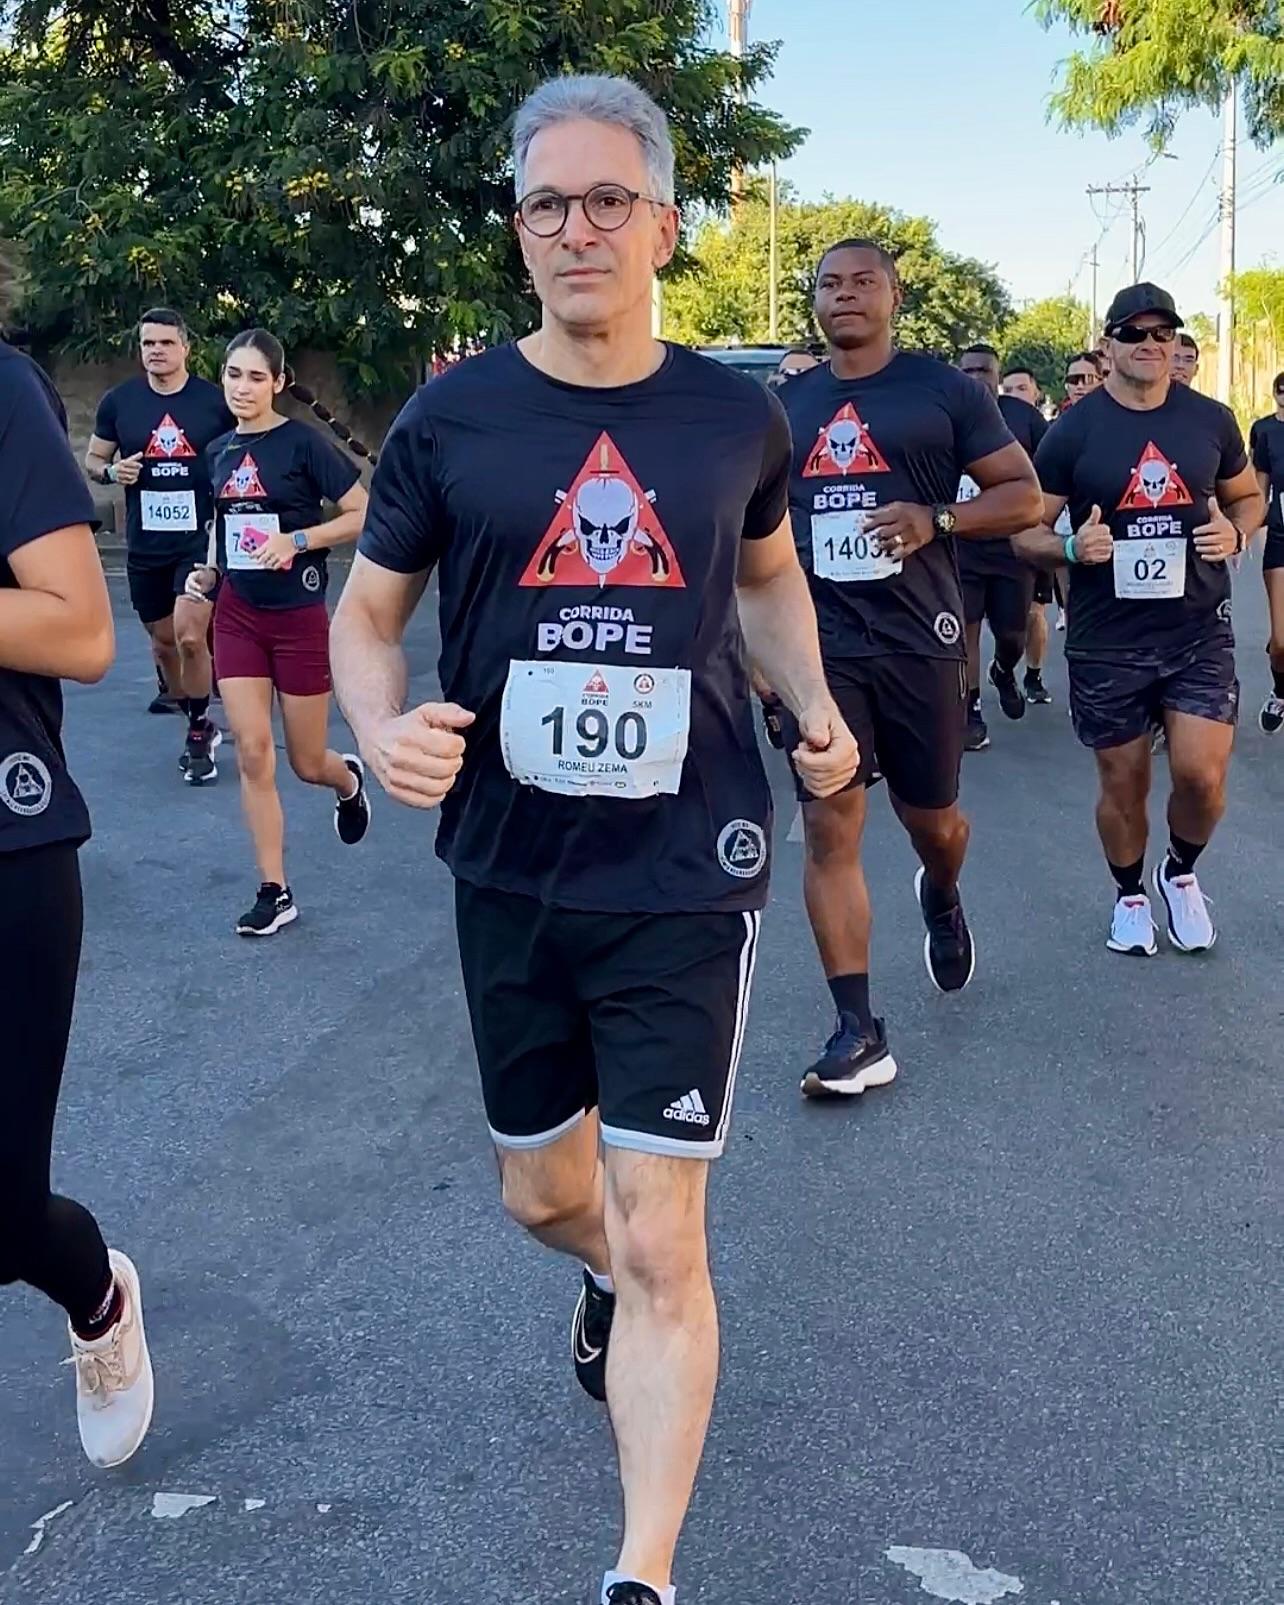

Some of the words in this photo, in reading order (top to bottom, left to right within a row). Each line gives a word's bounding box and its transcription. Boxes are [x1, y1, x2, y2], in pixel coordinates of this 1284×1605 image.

[151, 466, 189, 477] BOPE
[813, 491, 877, 510] BOPE
[148, 504, 190, 520] 14052
[1127, 521, 1182, 538] BOPE
[1134, 558, 1167, 581] 02
[559, 604, 635, 622] CORRIDA
[537, 620, 653, 655] BOPE
[541, 706, 648, 760] 190
[558, 759, 596, 773] ROMEU
[598, 761, 628, 774] ZEMA
[663, 1107, 710, 1126] adidas
